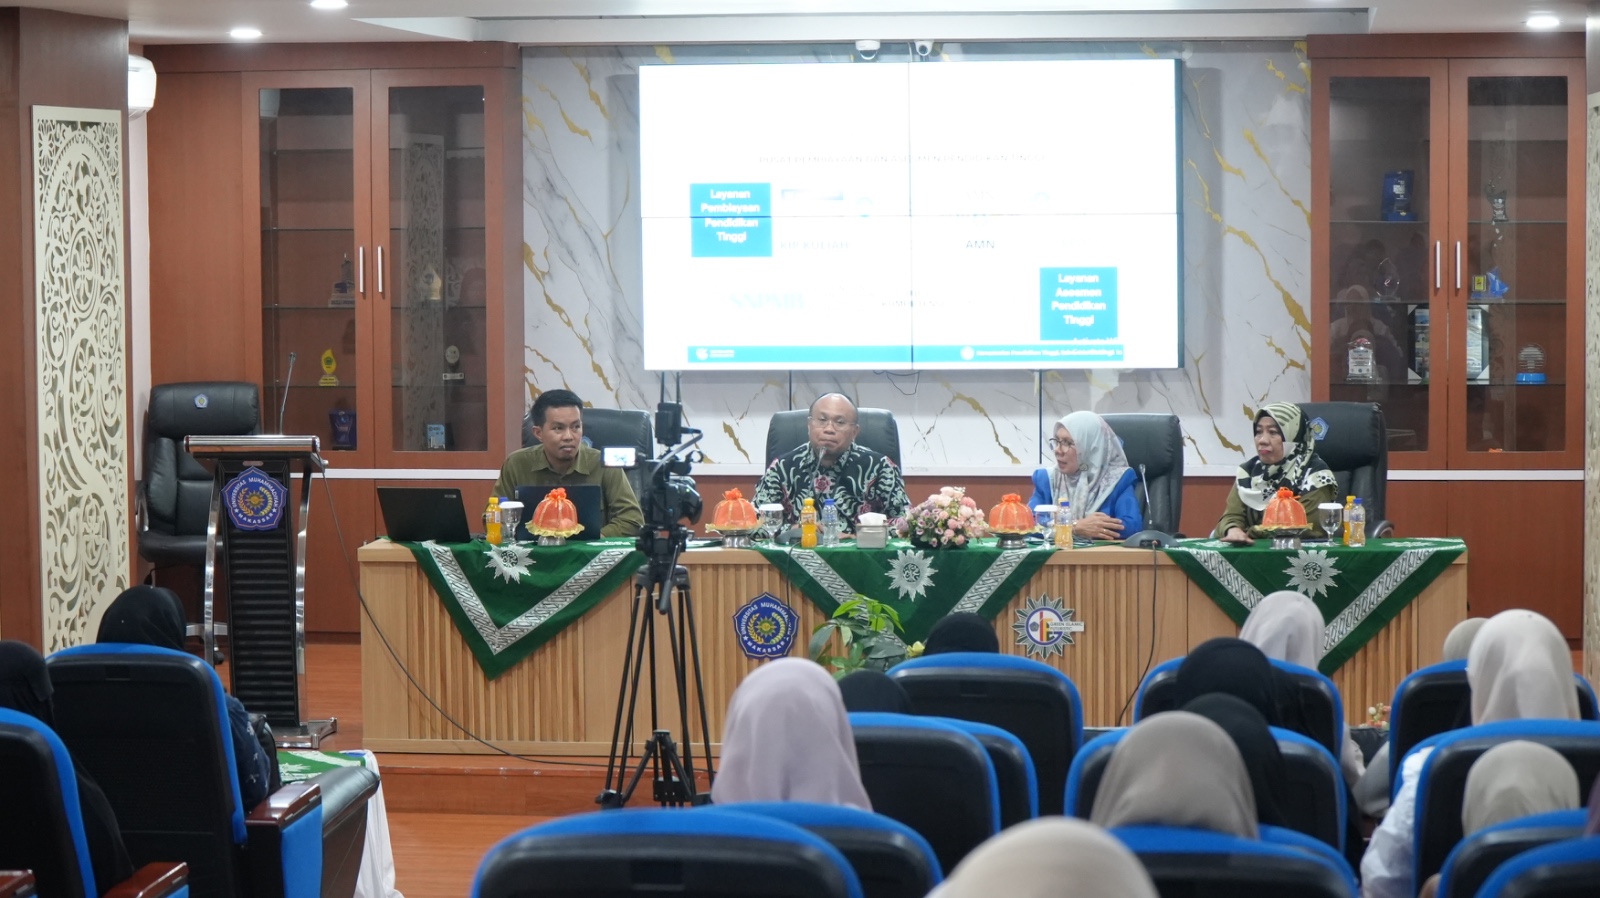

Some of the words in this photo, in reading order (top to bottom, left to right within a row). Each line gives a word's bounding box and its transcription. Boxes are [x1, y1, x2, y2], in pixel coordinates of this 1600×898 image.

[710, 189, 751, 201] Layanan
[700, 202, 760, 214] Pembiayaan
[704, 217, 759, 228] Pendidikan
[716, 231, 747, 243] Tinggi
[966, 240, 996, 249] AMN
[1058, 273, 1100, 285] Layanan
[1051, 300, 1107, 311] Pendidikan
[1063, 314, 1095, 327] Tinggi
[231, 479, 247, 508] UNIVERSITAS
[248, 477, 279, 507] MUHAMMADIYAH
[238, 513, 274, 524] MAKASSAR
[740, 604, 759, 635] UNIVERSITAS
[747, 641, 785, 653] MAKASSAR
